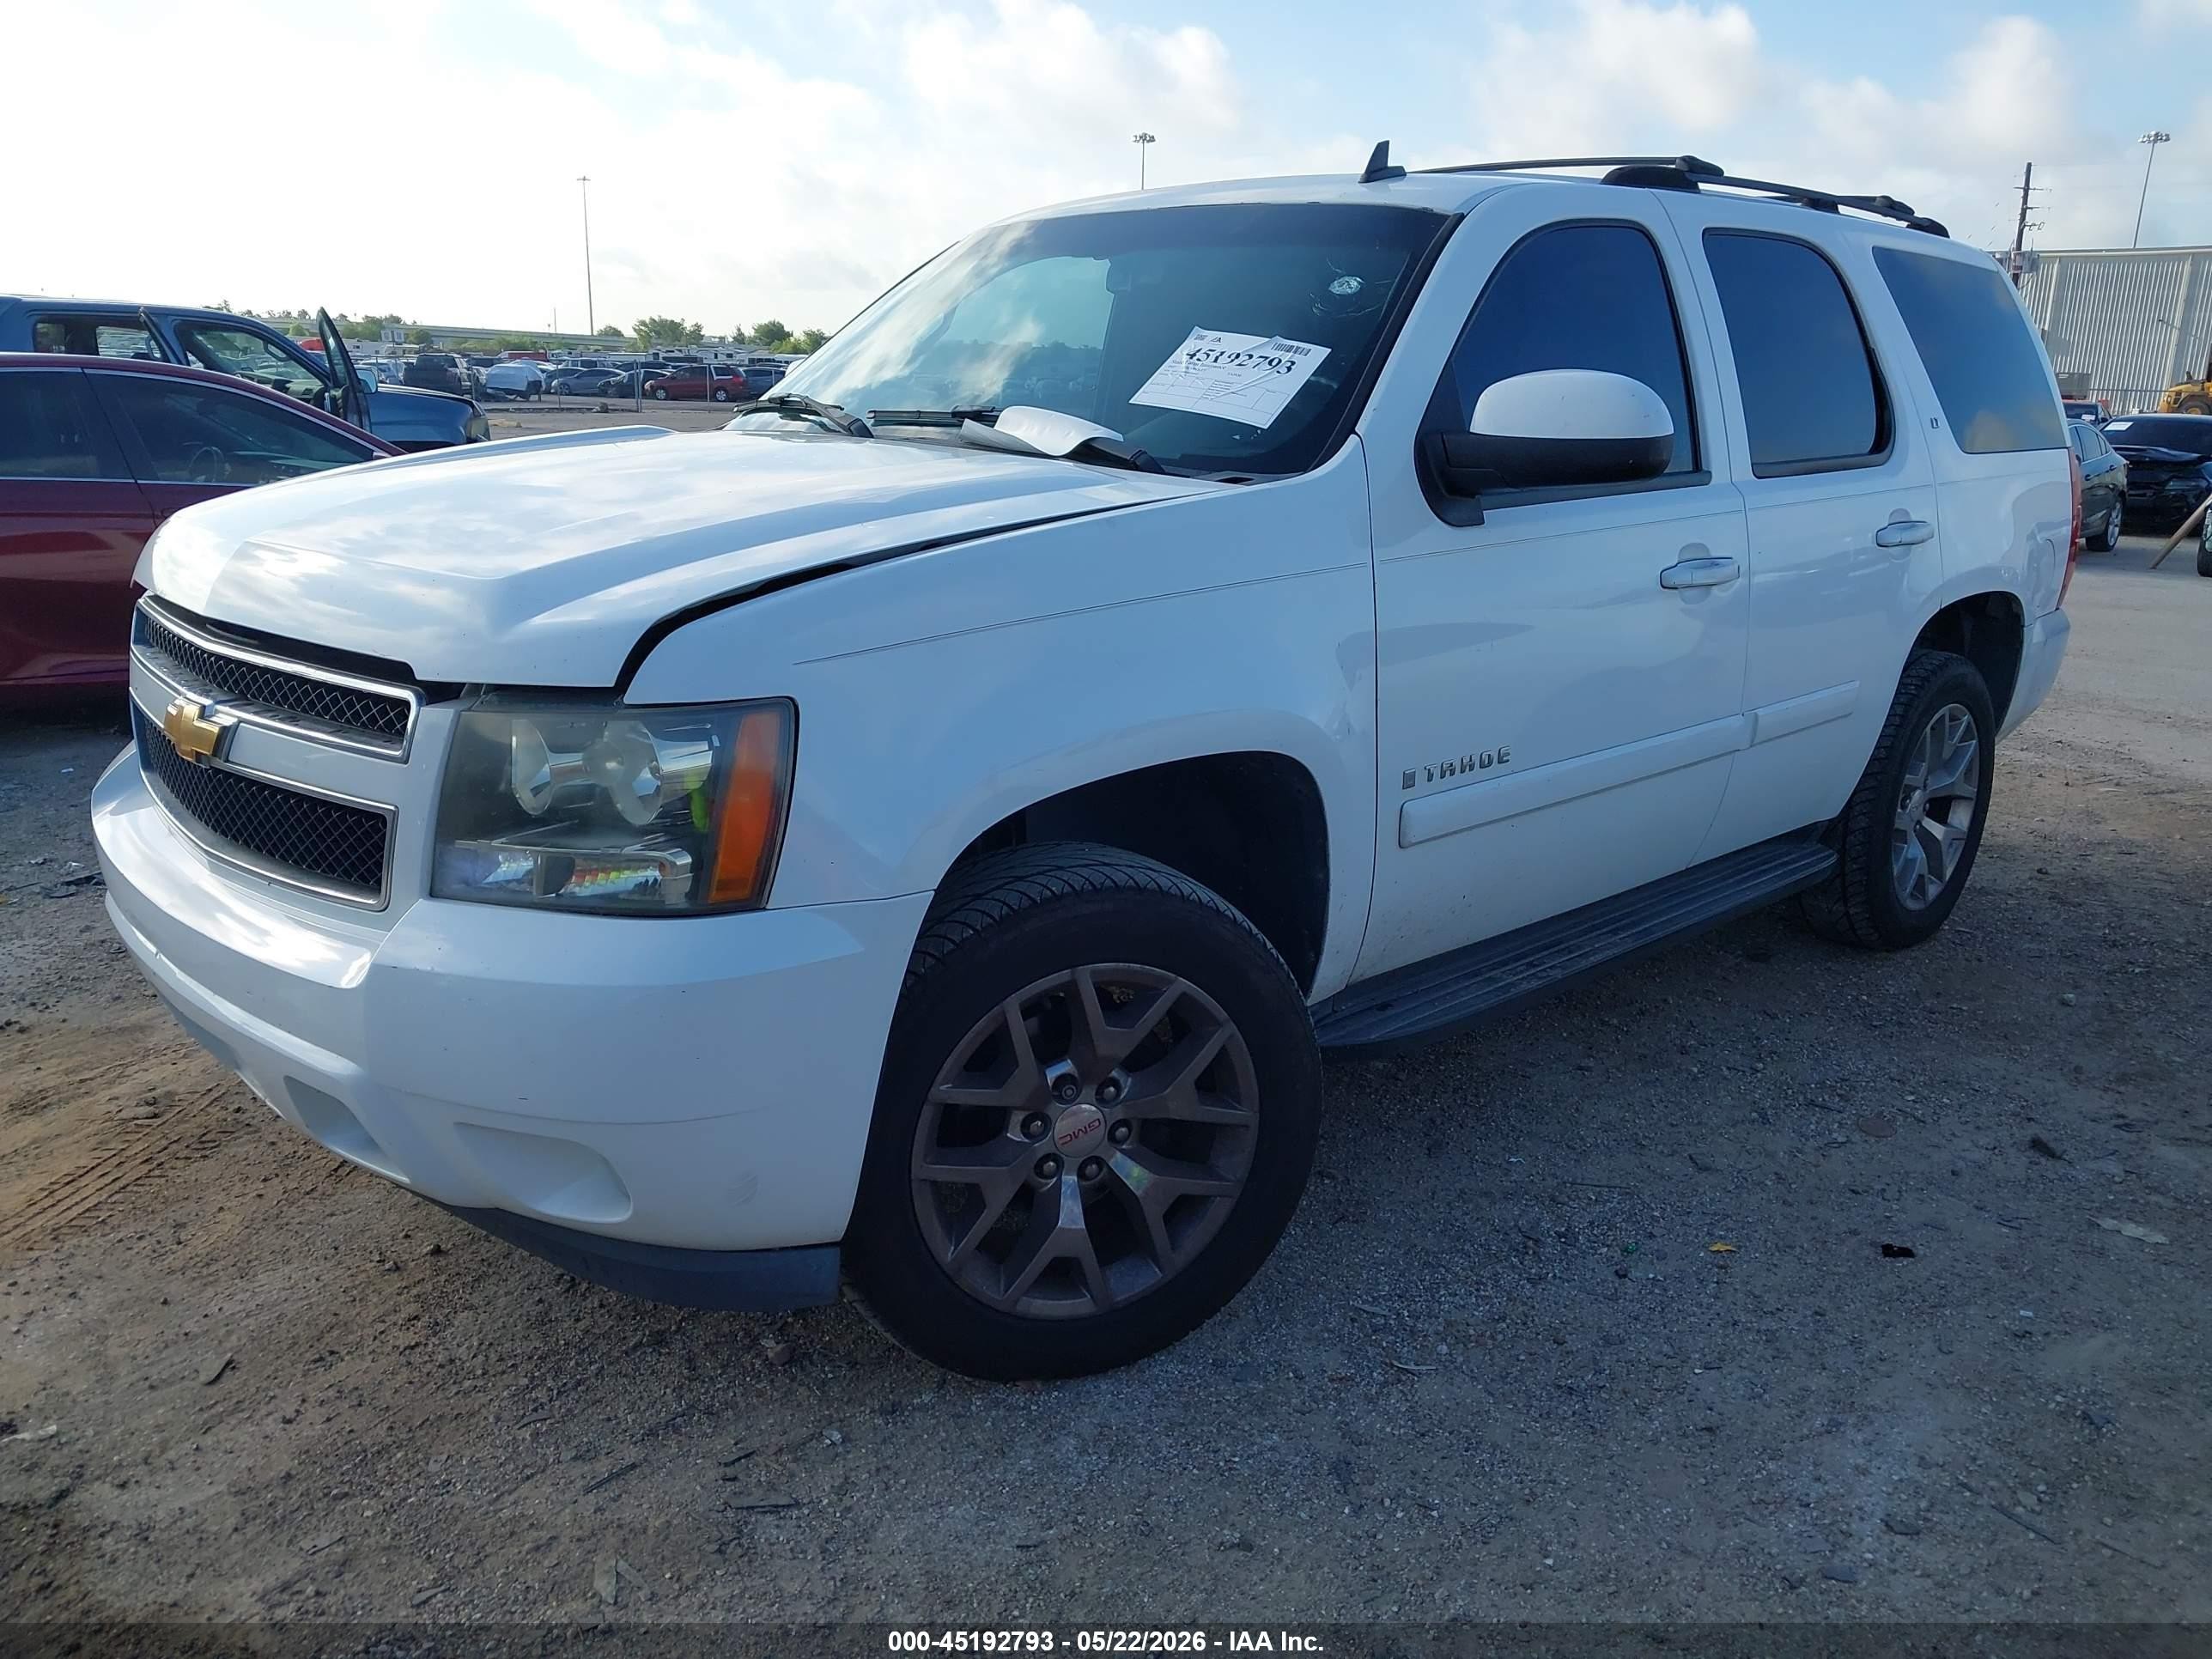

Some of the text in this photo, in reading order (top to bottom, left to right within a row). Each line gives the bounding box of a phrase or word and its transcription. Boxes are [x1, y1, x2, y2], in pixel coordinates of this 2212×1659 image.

[1185, 347, 1297, 375] 45192793
[1424, 744, 1511, 783] TAHOE
[1057, 1118, 1102, 1146] GMC
